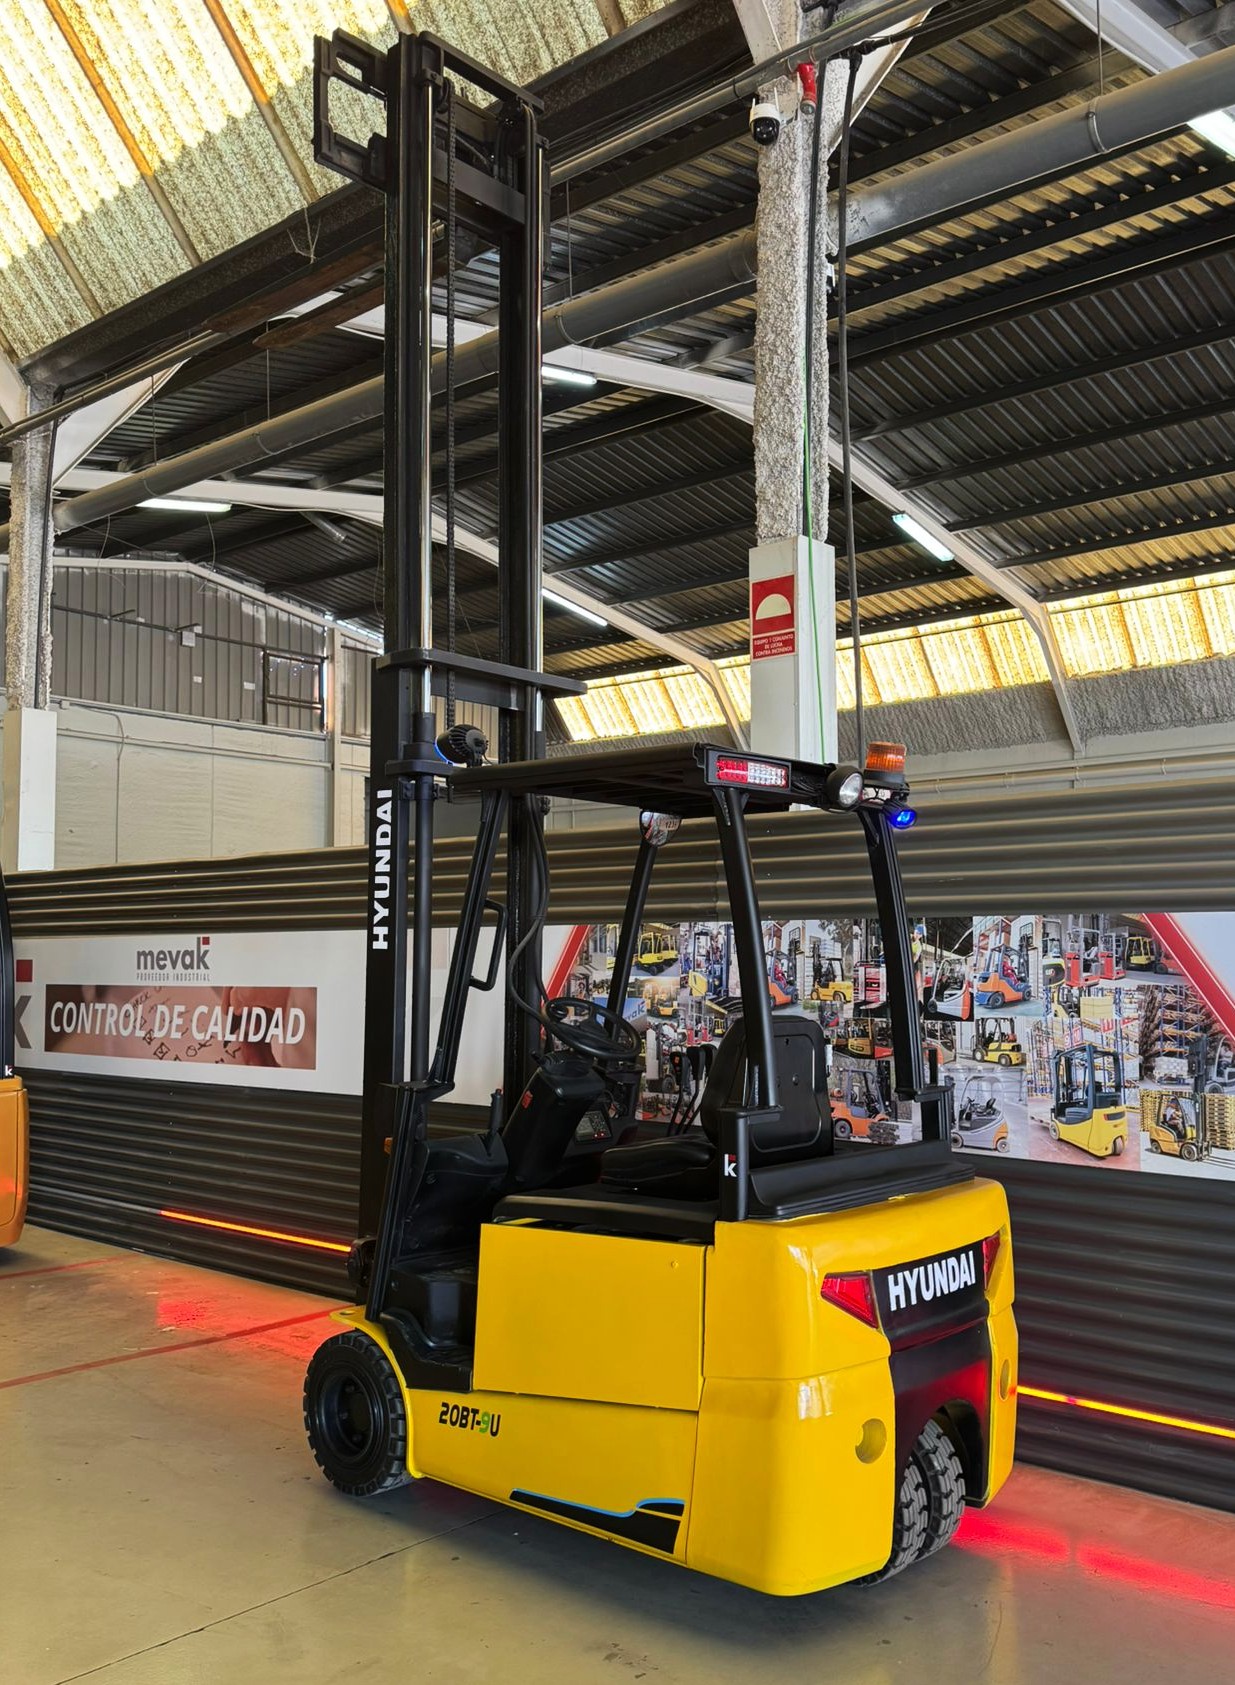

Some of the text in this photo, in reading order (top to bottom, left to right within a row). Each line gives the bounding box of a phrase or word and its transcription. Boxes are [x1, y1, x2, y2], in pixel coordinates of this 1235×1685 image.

[372, 789, 393, 949] HYUNDAI
[136, 936, 210, 971] mevak
[50, 1001, 306, 1045] CONTROL DE CALIDAD
[724, 1153, 738, 1178] k
[887, 1250, 977, 1313] HYUNDAI
[439, 1401, 502, 1437] 20BT-9U
